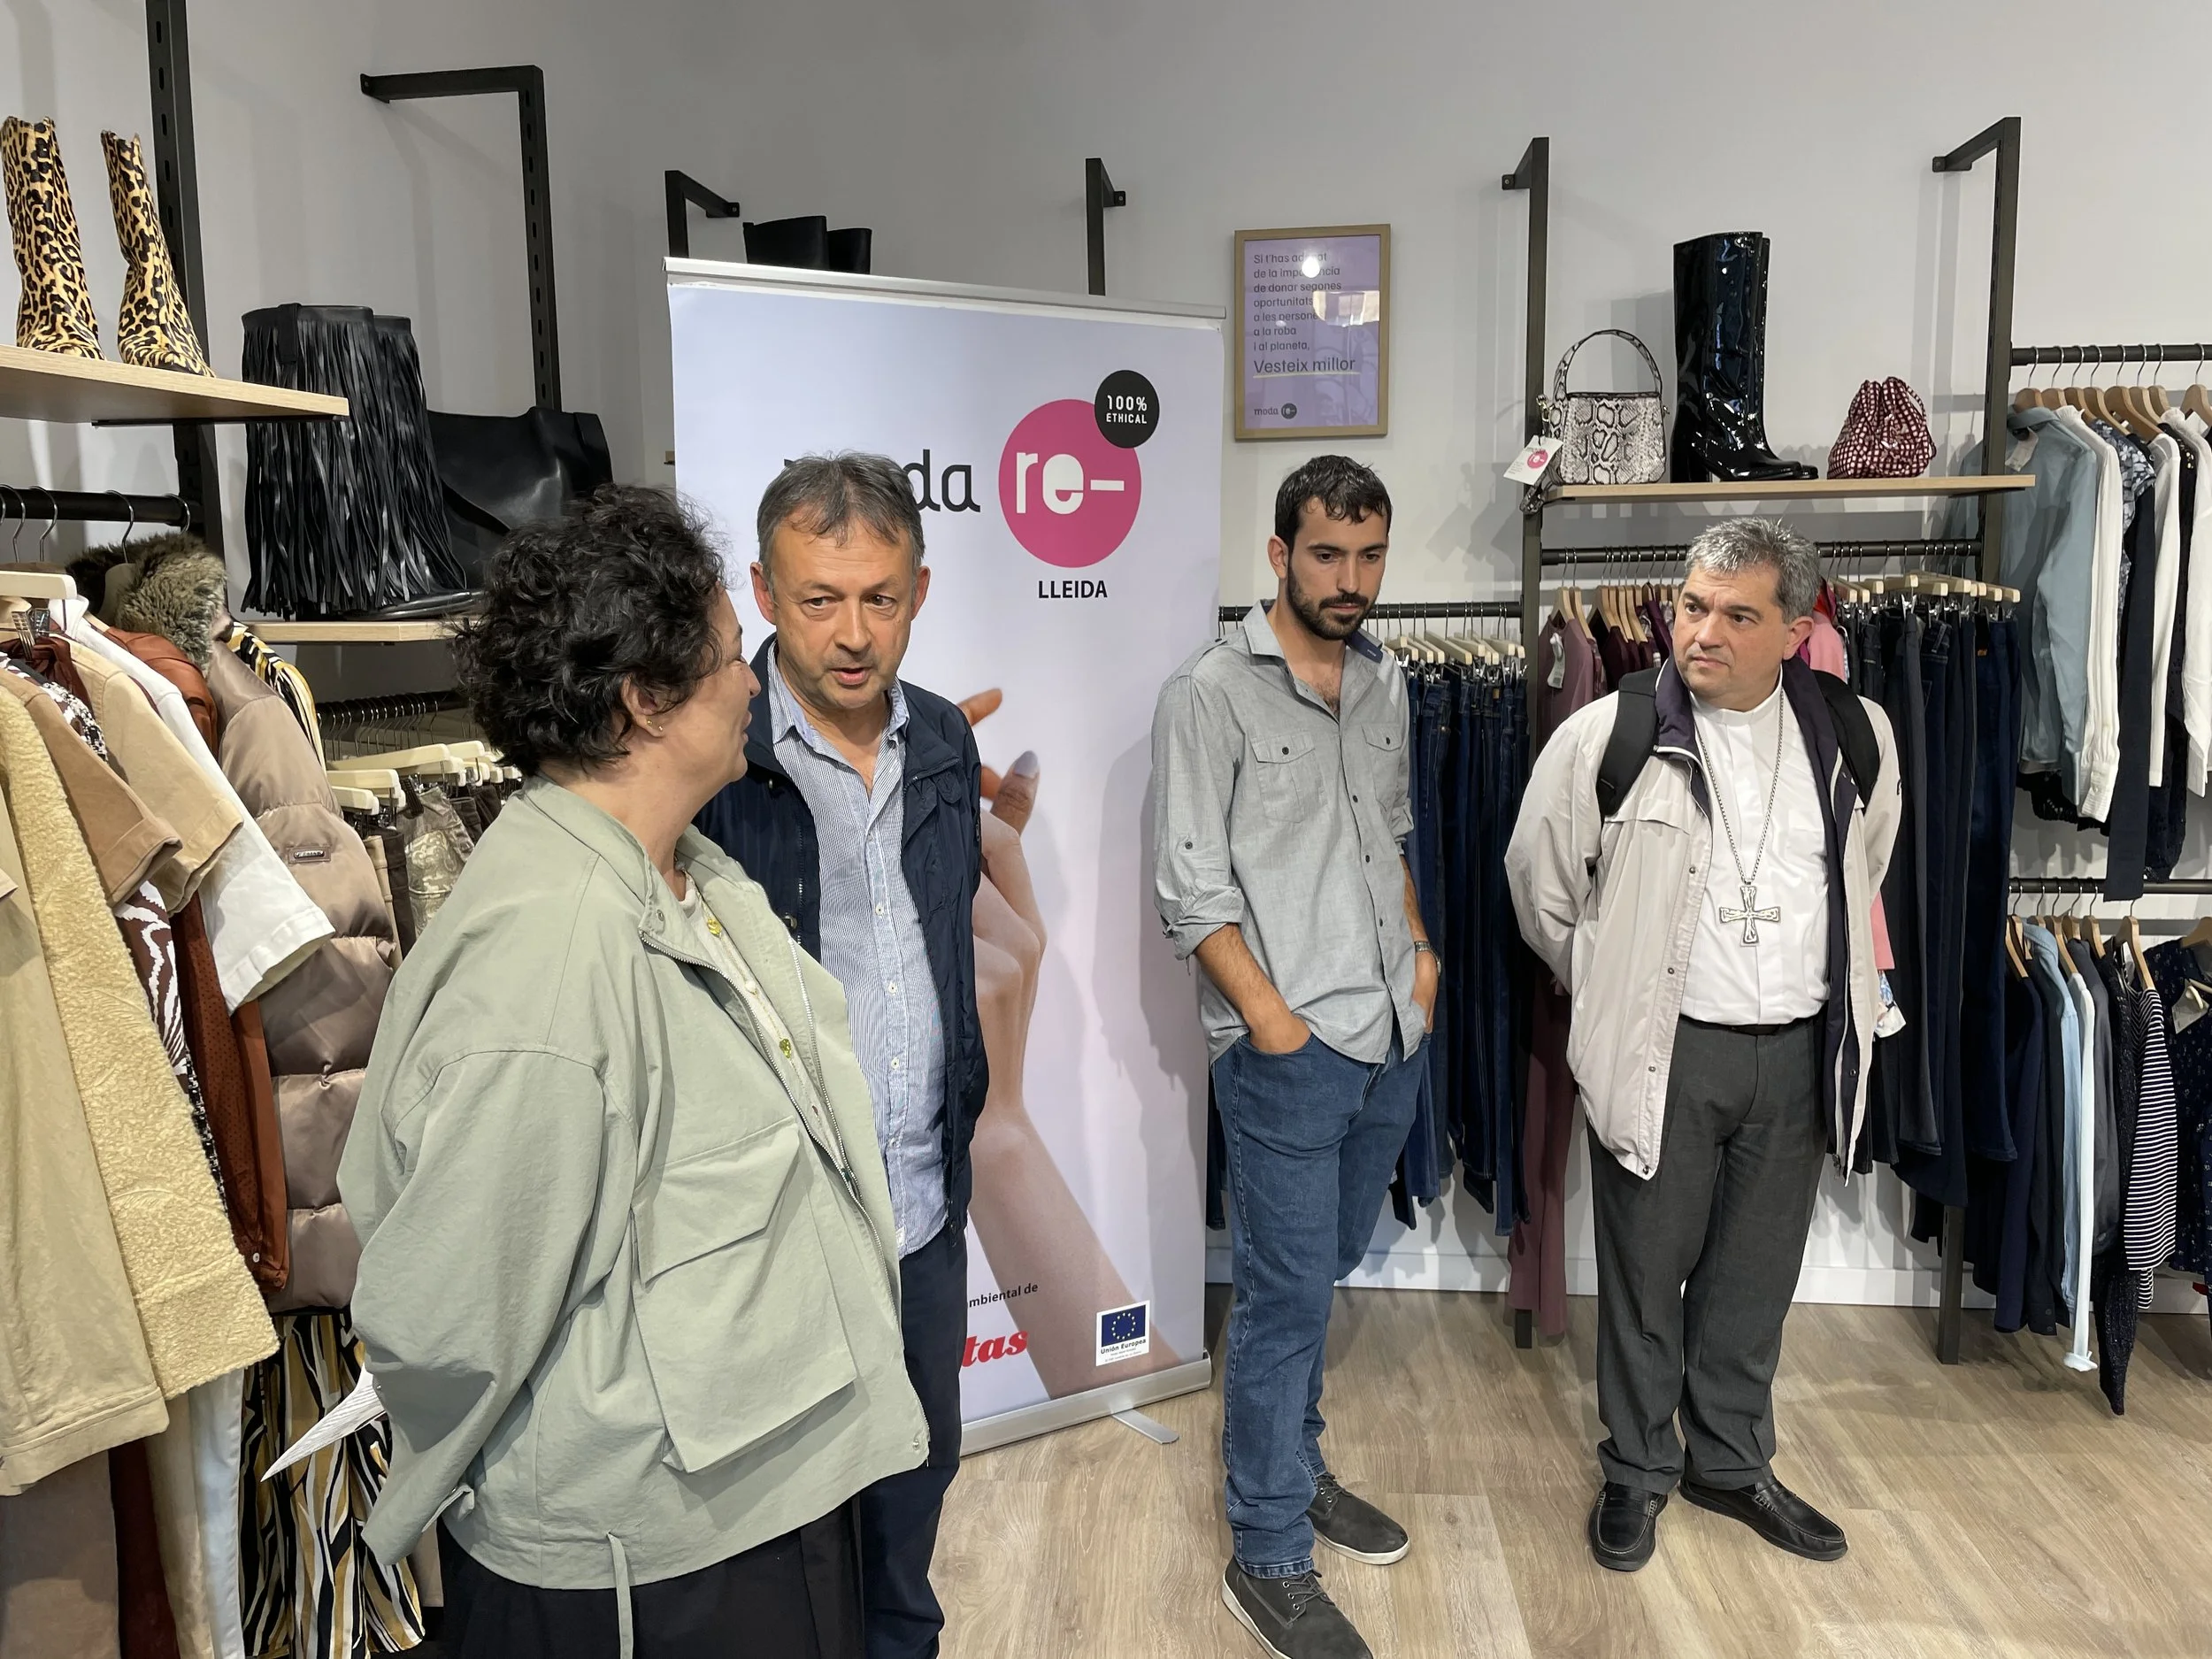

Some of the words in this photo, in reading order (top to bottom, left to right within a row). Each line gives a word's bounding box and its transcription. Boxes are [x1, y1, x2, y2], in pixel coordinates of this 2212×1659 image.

[1254, 255, 1263, 264] Si
[1265, 254, 1289, 263] t'has
[1292, 252, 1327, 262] adat
[1254, 269, 1266, 278] de
[1254, 284, 1266, 293] de
[1269, 283, 1297, 292] donar
[1301, 282, 1341, 292] segones
[1254, 297, 1313, 309] oportunitats
[1279, 311, 1318, 321] persone
[1274, 326, 1296, 335] roba
[1258, 342, 1267, 350] al
[1271, 342, 1310, 352] planeta,
[1253, 358, 1309, 373] Vesteix
[1313, 357, 1356, 371] millor
[1108, 395, 1148, 411] 100%
[1254, 407, 1279, 416] moda
[1106, 412, 1147, 424] ETHICAL
[1039, 580, 1108, 598] LLEIDA
[969, 1286, 1021, 1308] mbiental
[1025, 1283, 1038, 1294] de
[962, 1331, 1028, 1367] tas
[1121, 1340, 1146, 1349] Europea
